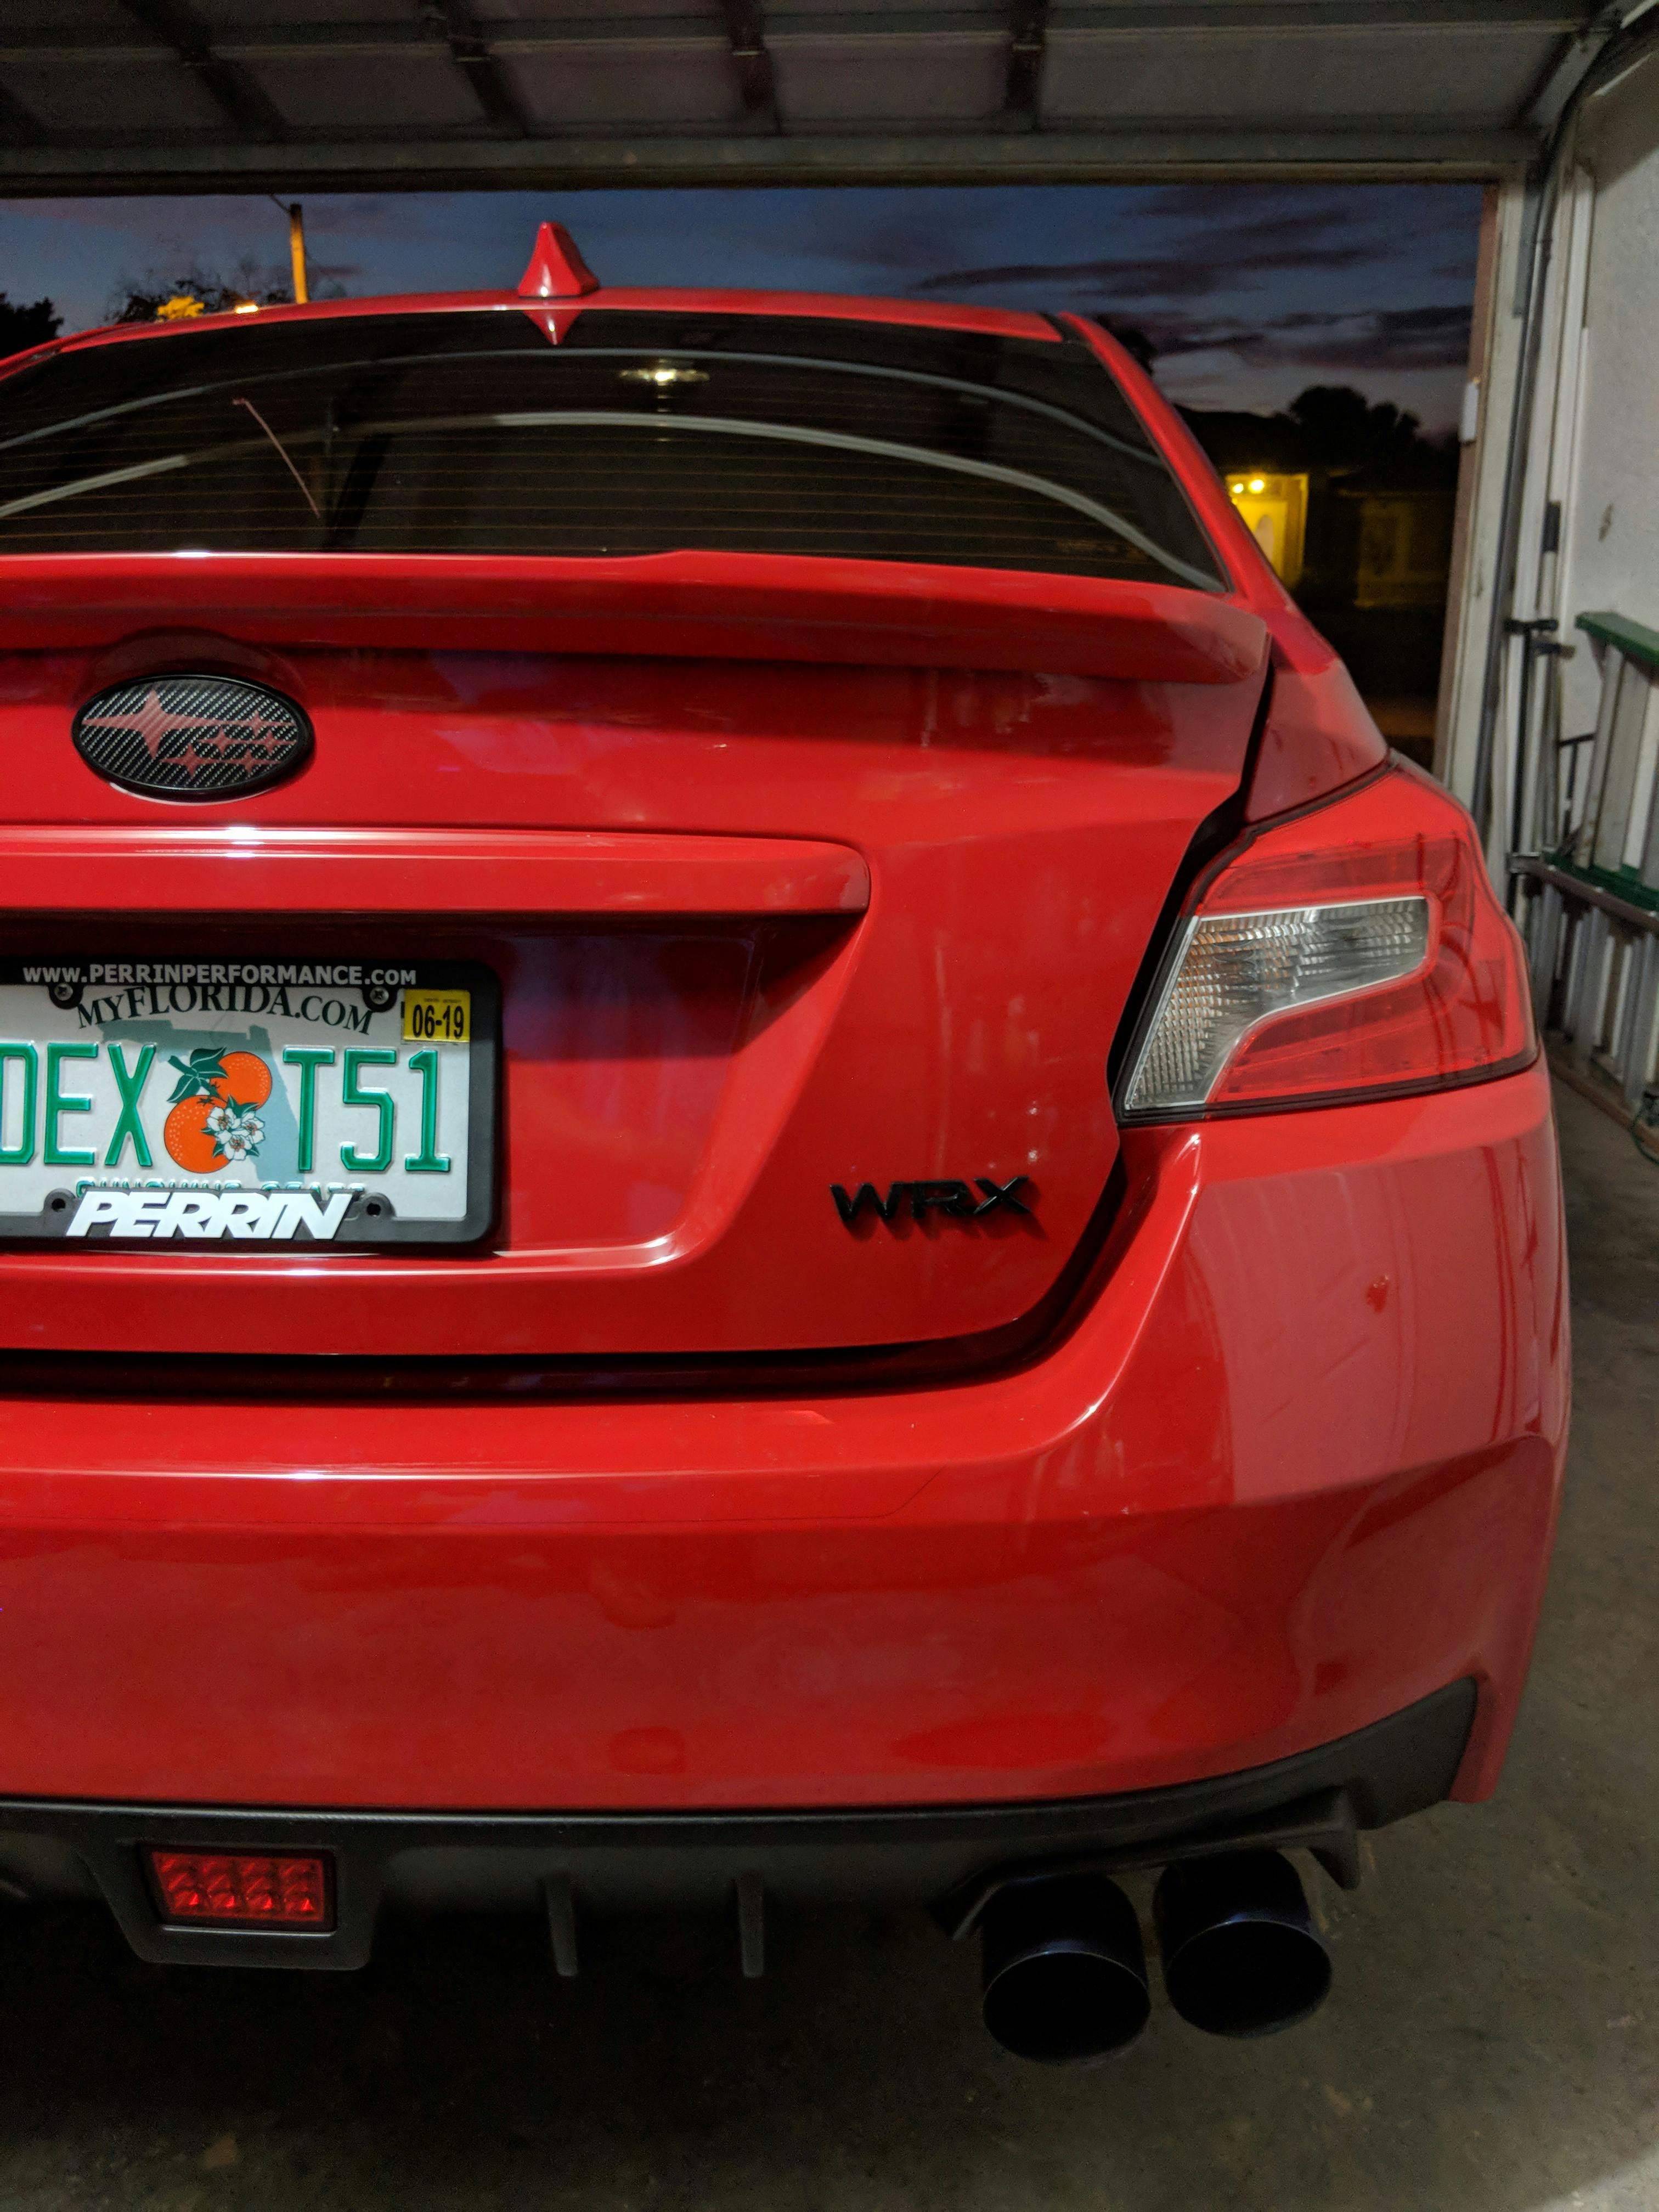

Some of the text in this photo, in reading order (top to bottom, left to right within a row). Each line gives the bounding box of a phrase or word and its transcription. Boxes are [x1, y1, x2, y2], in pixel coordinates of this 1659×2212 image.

[78, 986, 373, 1035] MYFLORIDA.COM
[412, 1003, 464, 1040] 06-19
[0, 1042, 452, 1172] DEX T51
[66, 1190, 353, 1240] PERRIN
[829, 1175, 1034, 1222] WRX
